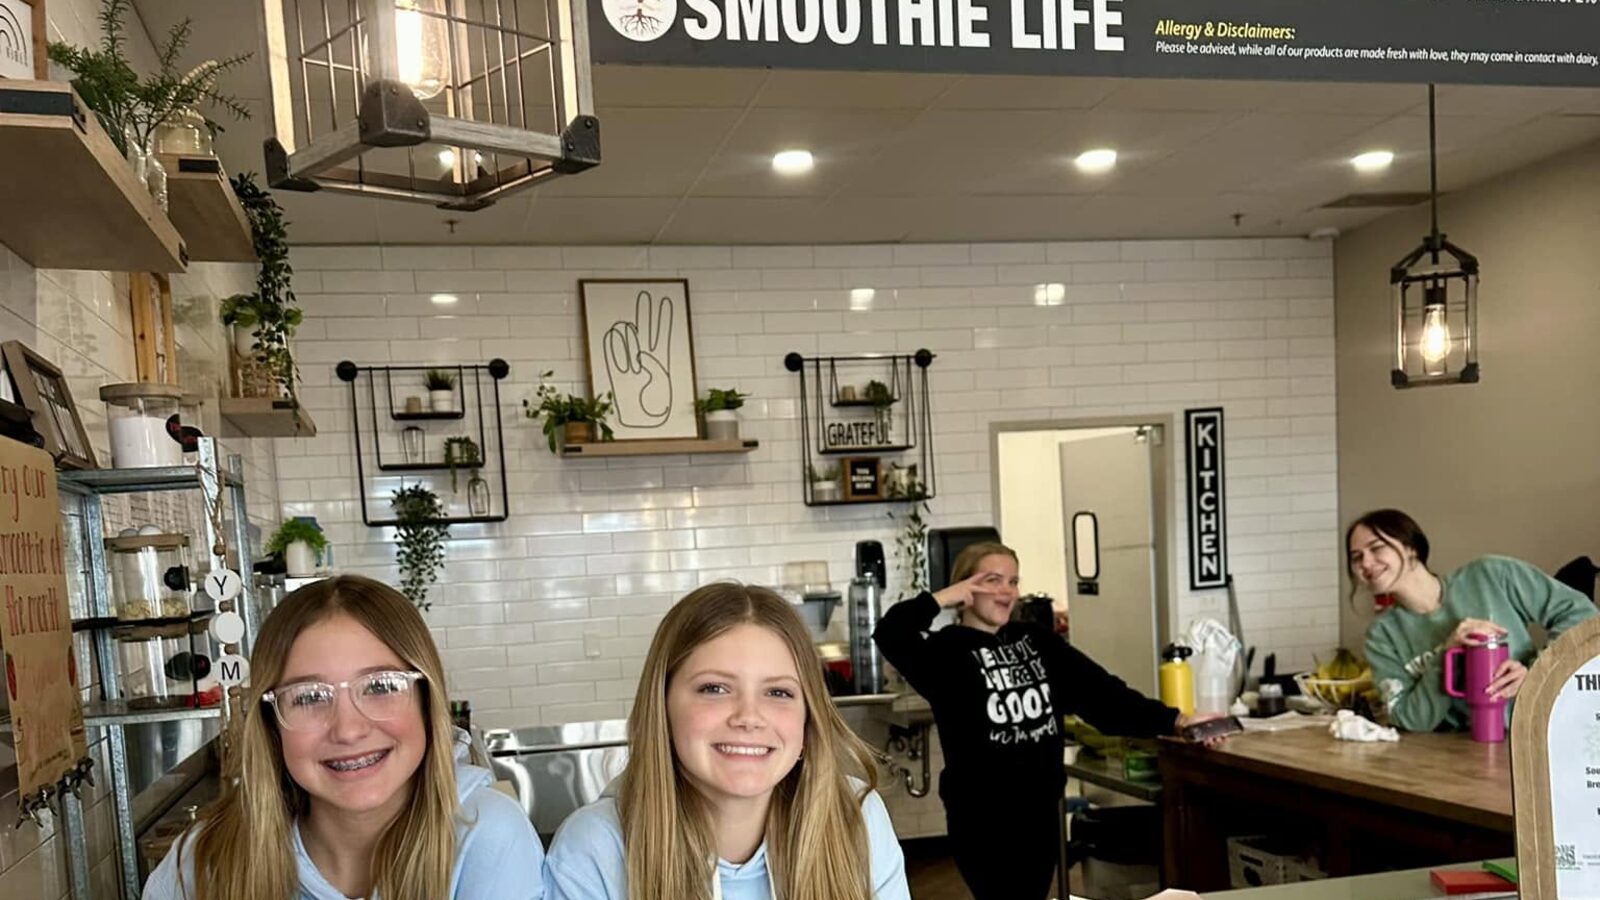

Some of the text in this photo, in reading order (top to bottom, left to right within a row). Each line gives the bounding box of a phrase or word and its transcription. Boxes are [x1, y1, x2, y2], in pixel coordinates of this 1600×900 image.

[1010, 0, 1125, 51] LIFE
[1155, 19, 1296, 40] Allergy & Disclaimers:
[1155, 41, 1185, 53] Please
[1187, 42, 1198, 54] be
[1200, 43, 1237, 56] advised,
[1238, 43, 1263, 56] while
[1264, 44, 1275, 56] all
[1277, 45, 1287, 57] of
[1288, 47, 1303, 57] our
[1304, 45, 1343, 60] products
[1344, 49, 1359, 59] are
[1360, 47, 1386, 59] made
[1386, 47, 1408, 60] fresh
[1409, 48, 1428, 60] with
[1429, 49, 1450, 62] love,
[1450, 49, 1470, 64] they
[1470, 52, 1489, 64] may
[1490, 52, 1513, 63] come
[1515, 51, 1523, 63] in
[1524, 53, 1556, 64] contact
[1556, 53, 1575, 64] with
[827, 421, 893, 446] GRATEFUL
[0, 465, 19, 523] ry
[1197, 423, 1217, 576] KITCHEN
[1574, 674, 1600, 691] TH
